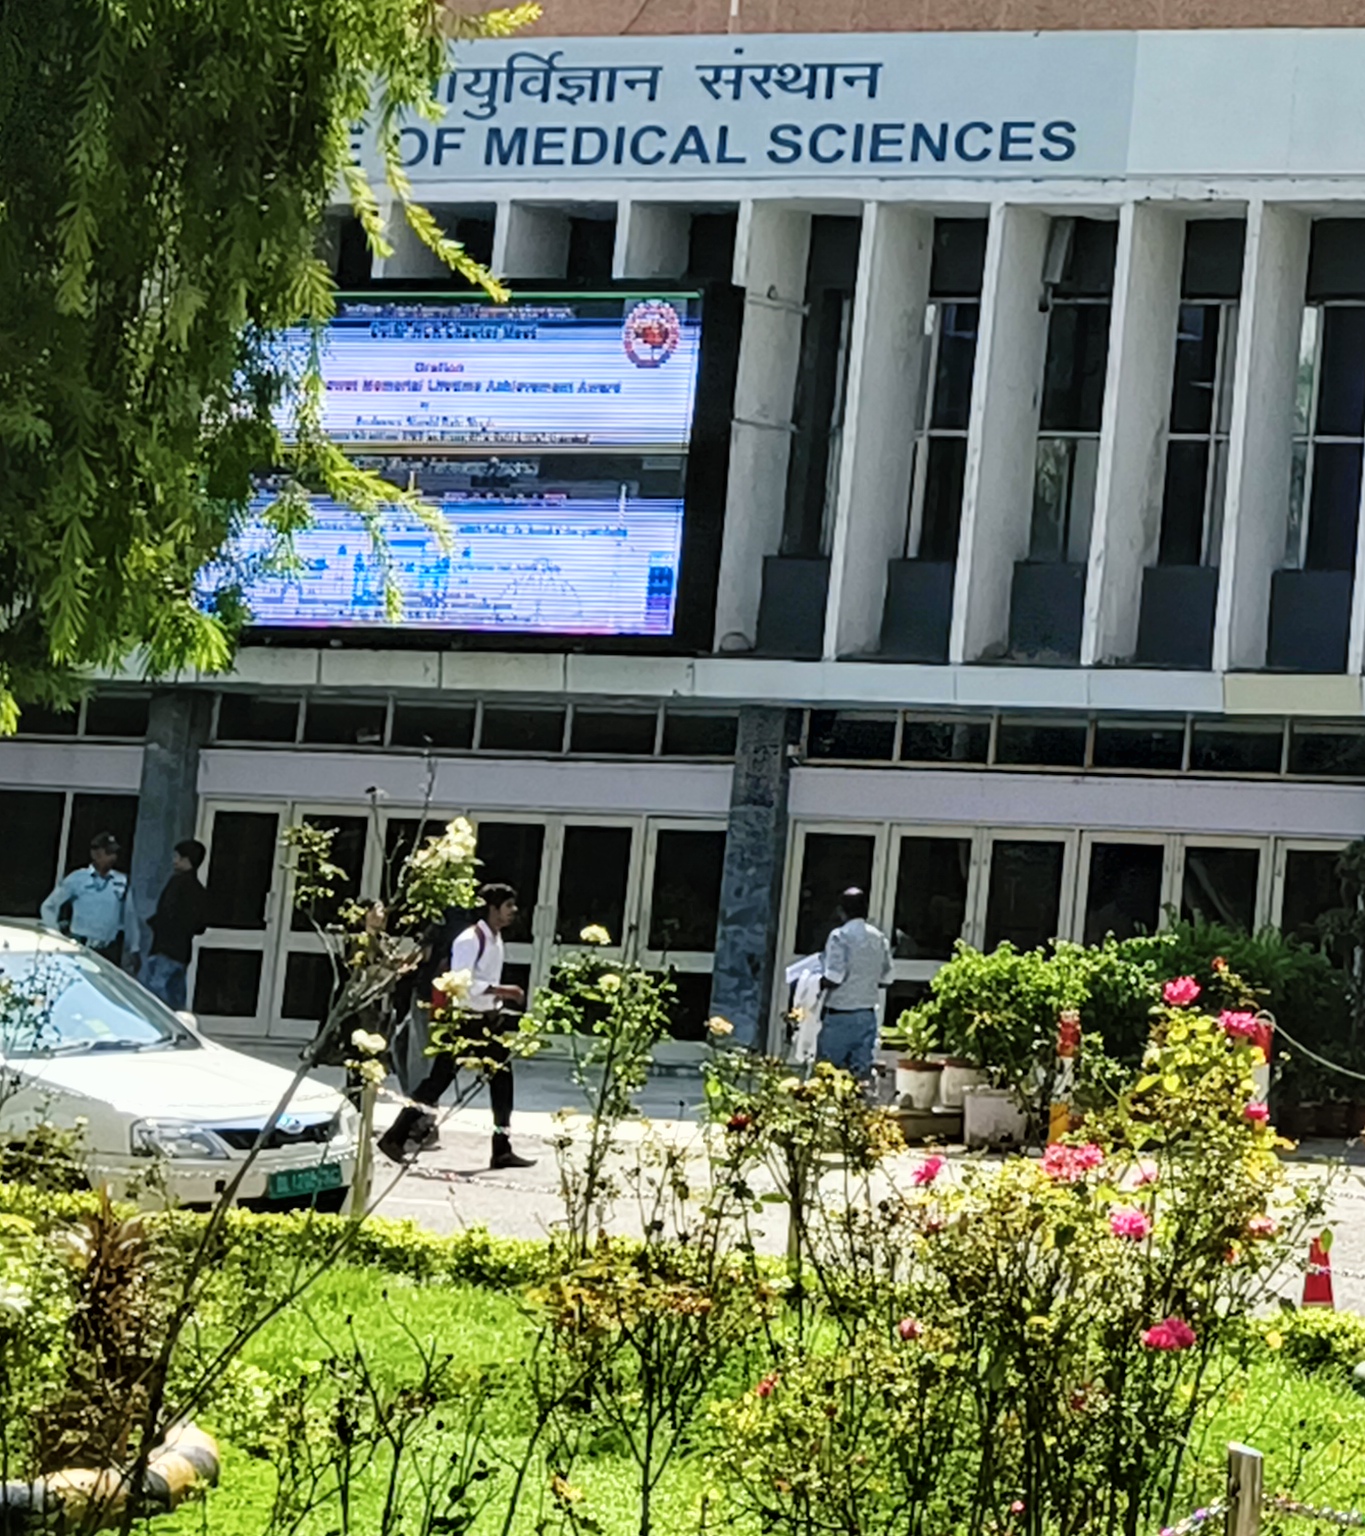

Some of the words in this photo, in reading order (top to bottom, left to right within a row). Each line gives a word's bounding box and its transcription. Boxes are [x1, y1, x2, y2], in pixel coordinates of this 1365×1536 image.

[696, 47, 883, 105] संस्थान
[397, 126, 465, 167] OF
[484, 124, 747, 167] MEDICAL
[767, 120, 1079, 164] SCIENCES
[577, 378, 622, 394] Award
